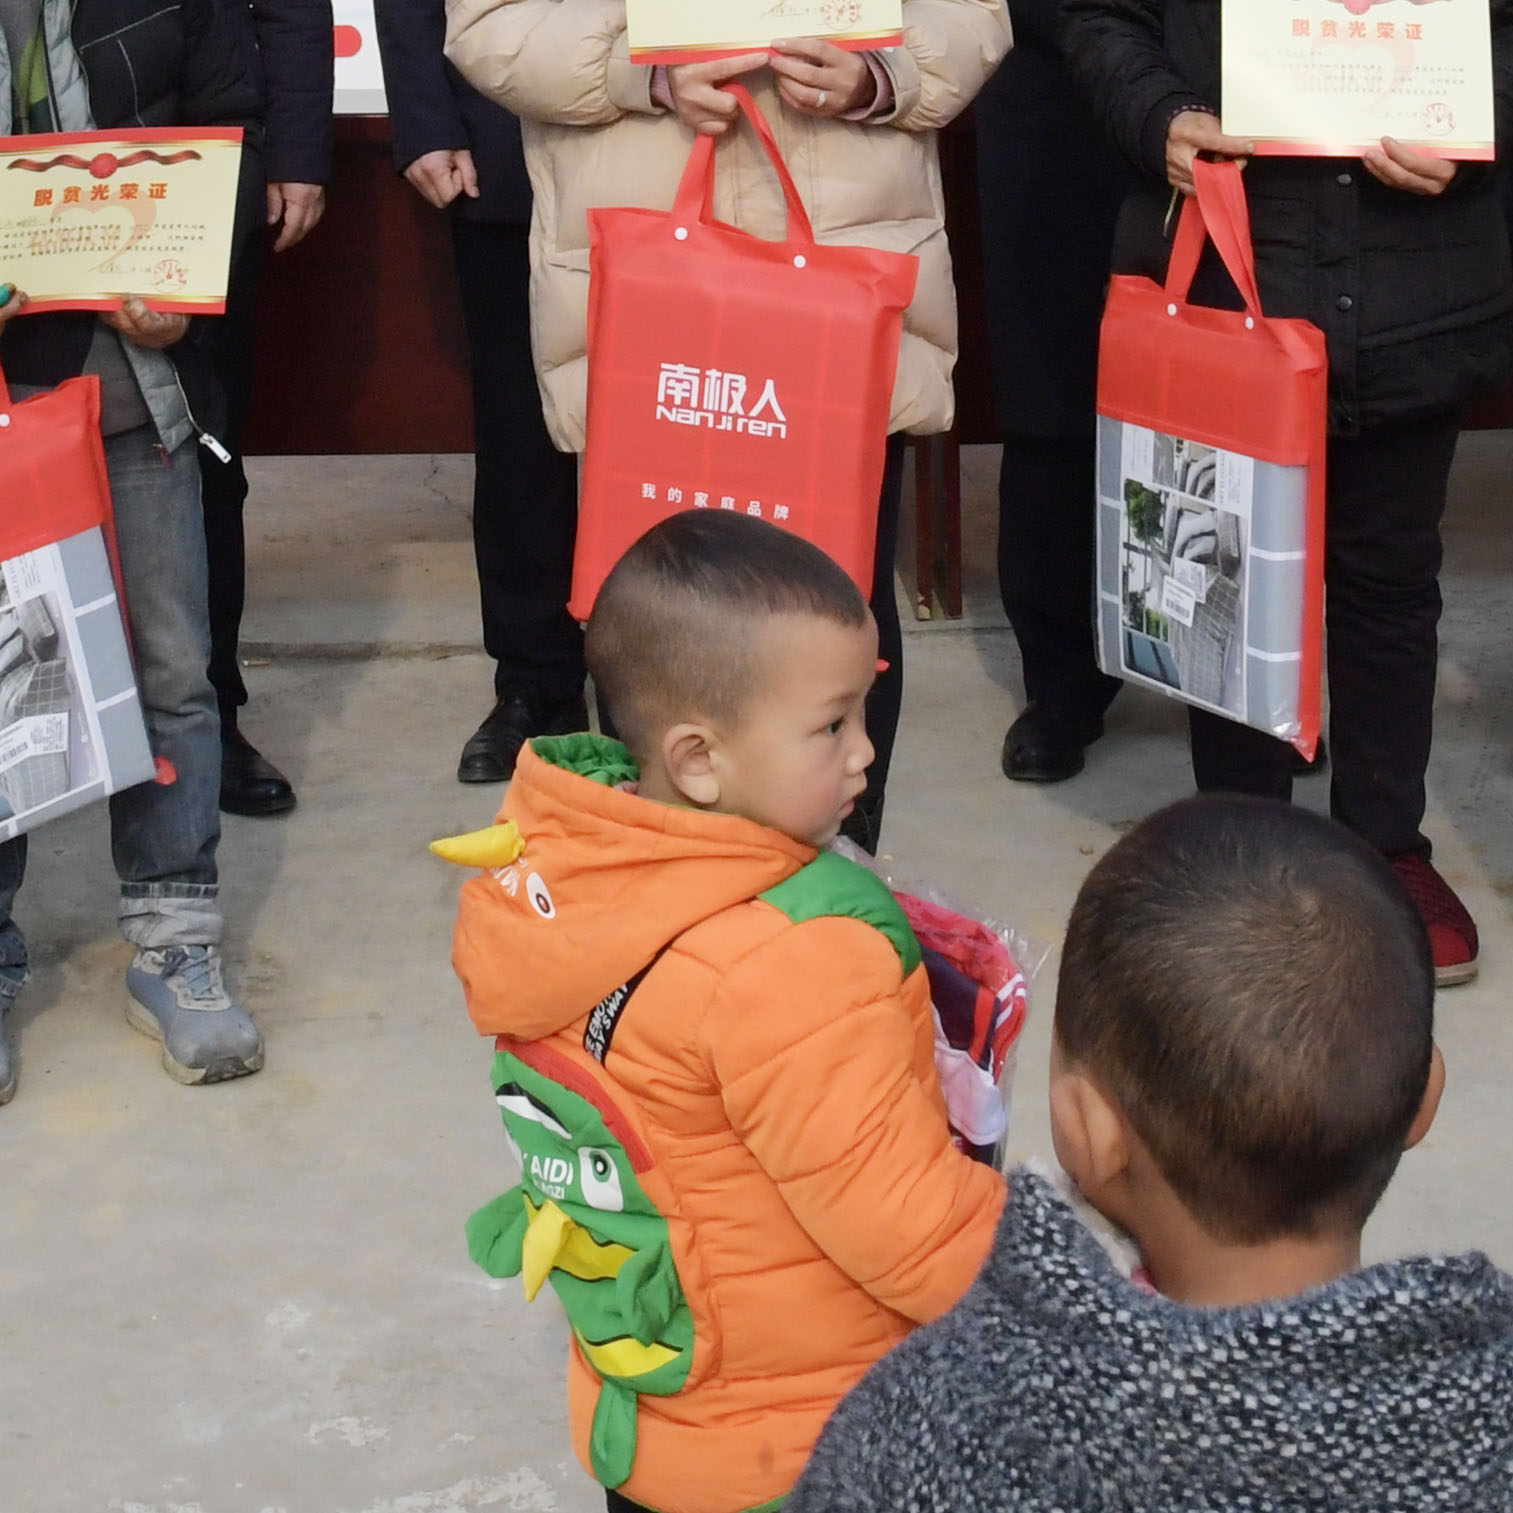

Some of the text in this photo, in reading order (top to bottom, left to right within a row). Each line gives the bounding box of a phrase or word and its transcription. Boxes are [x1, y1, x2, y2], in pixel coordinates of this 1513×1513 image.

[1291, 18, 1423, 41] 脱贫光荣证
[33, 182, 168, 207] 脱贫光荣证
[656, 361, 787, 423] 南极人
[641, 482, 790, 521] 我的家庭品牌
[523, 1152, 574, 1186] AIDI
